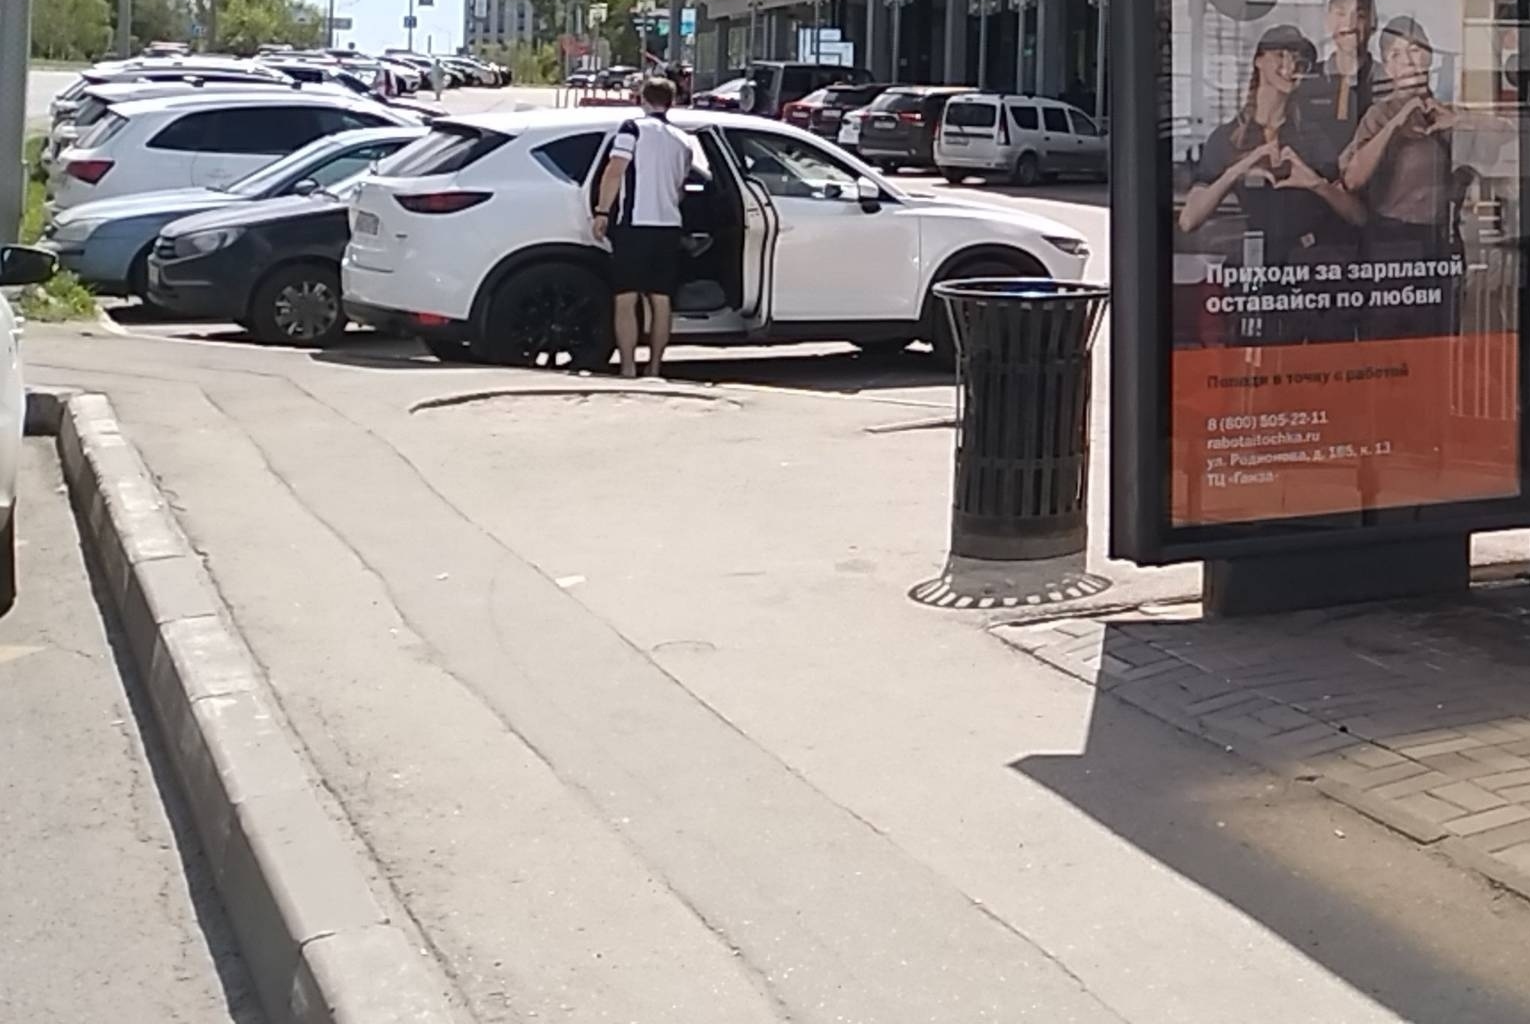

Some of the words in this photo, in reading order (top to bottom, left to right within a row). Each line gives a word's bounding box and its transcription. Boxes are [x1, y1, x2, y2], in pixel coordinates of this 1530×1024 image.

[1205, 261, 1310, 288] Приходи
[1315, 263, 1342, 281] за
[1347, 255, 1464, 283] зарплатой
[1205, 288, 1332, 314] оставайся
[1336, 291, 1364, 308] по
[1368, 286, 1442, 308] любви
[1273, 372, 1283, 385] в
[1286, 369, 1331, 387] точку
[1345, 362, 1411, 384] работой
[1207, 417, 1218, 432] 8
[1219, 415, 1257, 433] (800)
[1207, 472, 1227, 489] ТЦ
